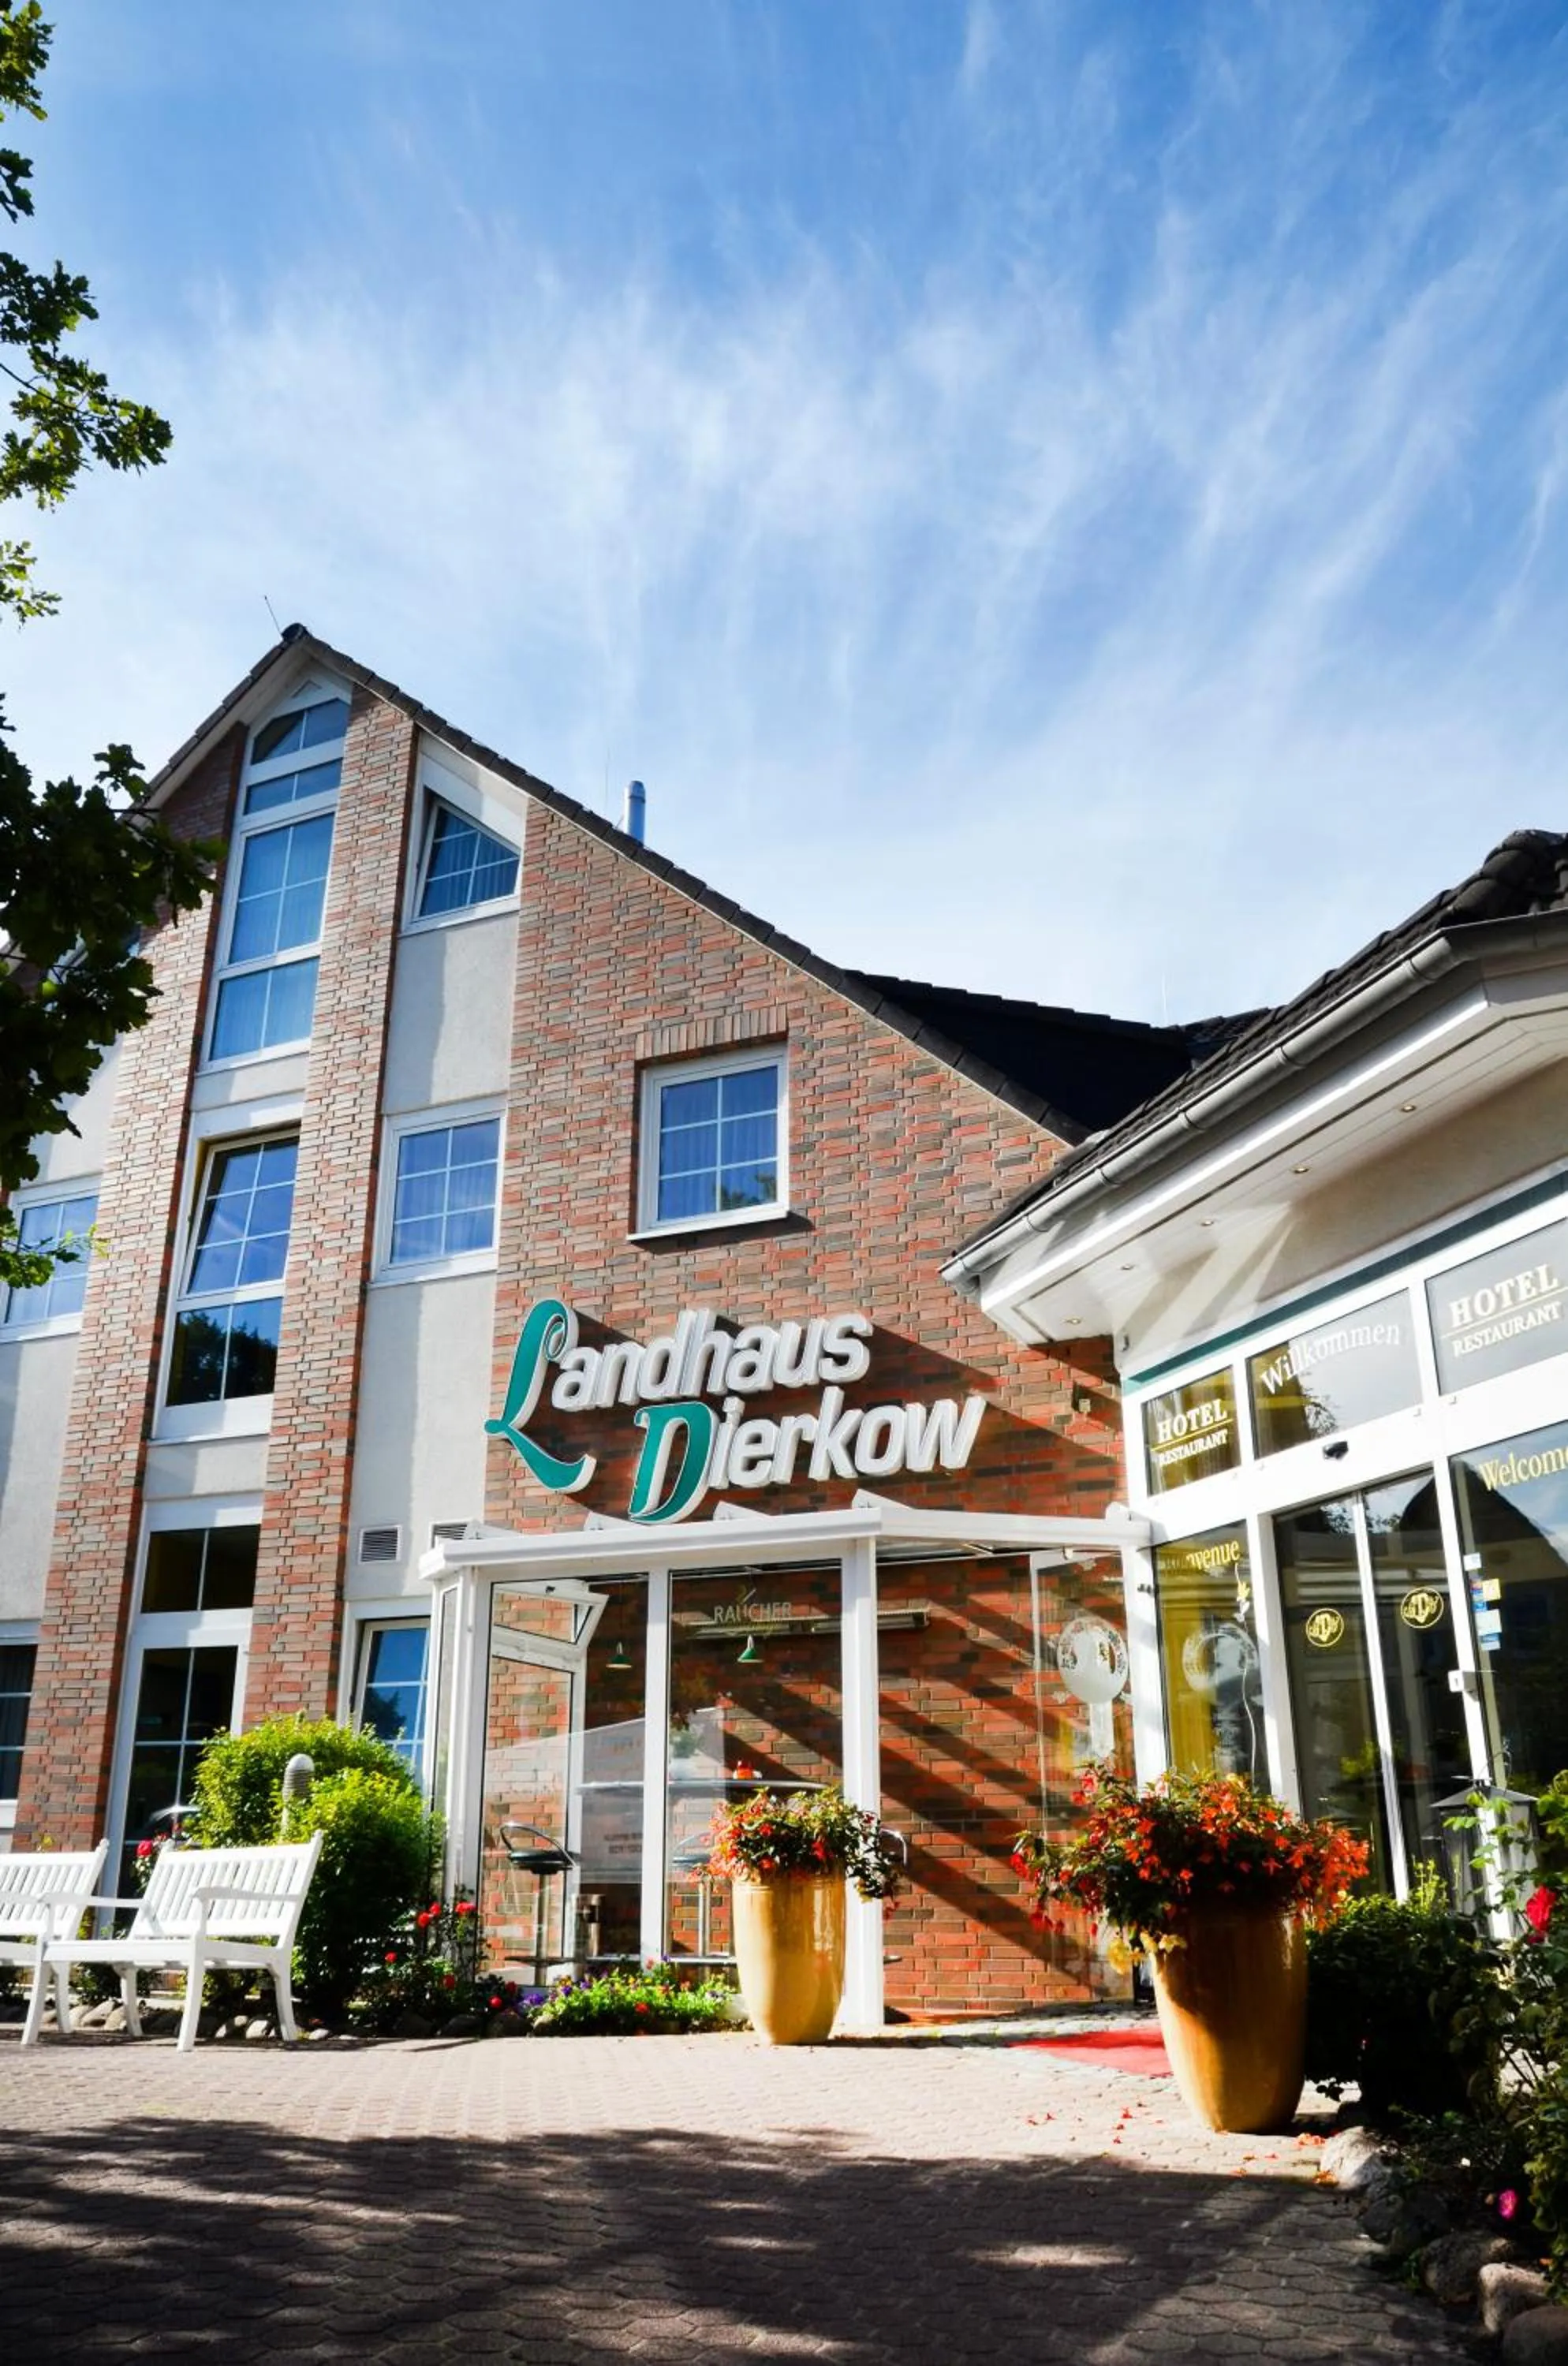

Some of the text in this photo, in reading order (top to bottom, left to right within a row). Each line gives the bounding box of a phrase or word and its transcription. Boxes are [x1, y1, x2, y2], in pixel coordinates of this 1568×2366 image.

[1449, 1263, 1559, 1328] HOTEL
[1260, 1323, 1400, 1395] Willkommen
[1451, 1301, 1562, 1358] RESTAURANT
[484, 1297, 873, 1495] Landhaus
[1157, 1398, 1228, 1444] HOTEL
[629, 1386, 987, 1525] Dierkow
[1159, 1428, 1228, 1467] RESTAURANT
[1479, 1446, 1568, 1491] Welcom
